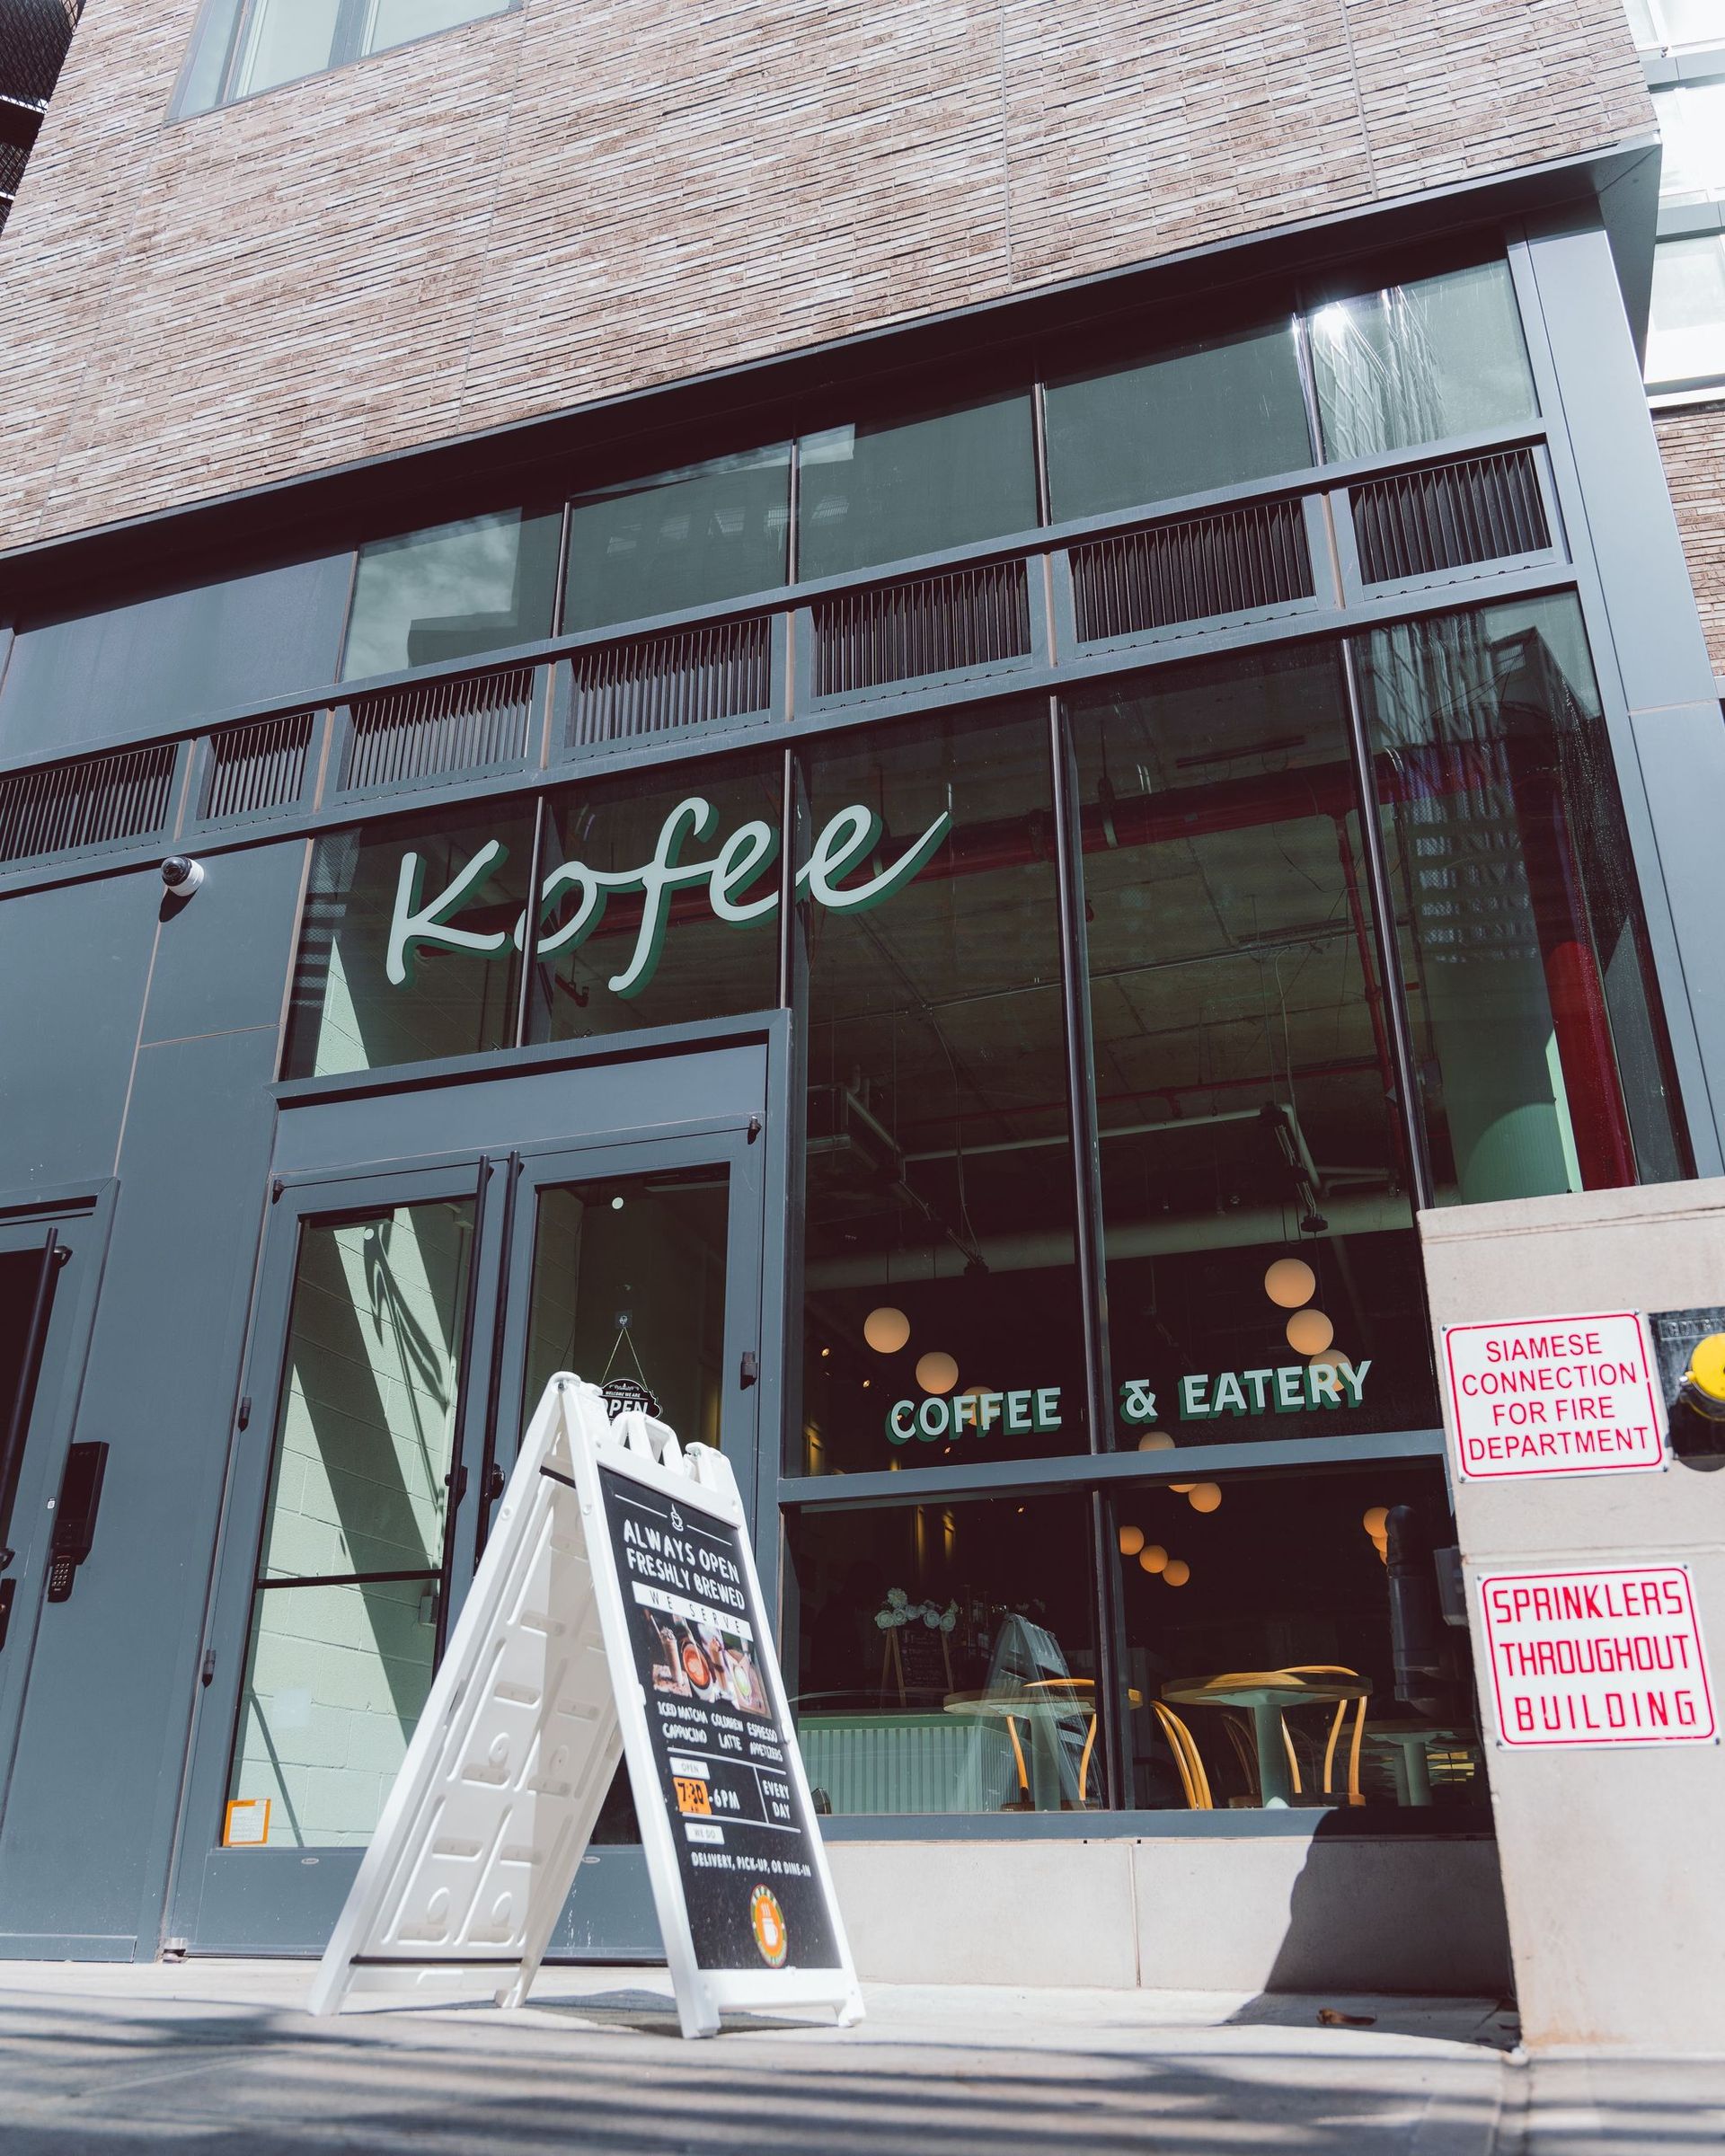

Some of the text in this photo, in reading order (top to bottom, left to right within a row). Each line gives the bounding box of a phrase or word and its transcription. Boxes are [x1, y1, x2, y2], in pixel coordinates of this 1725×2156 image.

[385, 797, 950, 993] Kofee
[1486, 1332, 1603, 1363] SIAMESE
[1463, 1362, 1637, 1396] CONNECTION
[606, 1399, 649, 1417] PEN
[888, 1360, 1372, 1441] COFFEE & EATERY
[1492, 1396, 1615, 1427] FOR FIRE
[1469, 1427, 1650, 1461] DEPARTMENT
[624, 1519, 740, 1585] ALWAYS OPEN
[626, 1547, 745, 1611] FRESHLY BREWED
[650, 1589, 741, 1633] WE SERVE
[1493, 1580, 1684, 1623] SPRINKLERS
[1499, 1634, 1689, 1676] THROUGHOUT
[657, 1701, 708, 1724] ICED MATCHA
[1515, 1690, 1696, 1732] BUILDING
[718, 1732, 743, 1751] LATTE
[747, 1721, 778, 1743] ESPRESSO
[749, 1742, 783, 1762] APPETIZERS
[762, 1780, 790, 1800] EVERY
[772, 1801, 791, 1819] DAY
[691, 1851, 811, 1878] DELIVERY, PICK-UP, OR DINE-IN
